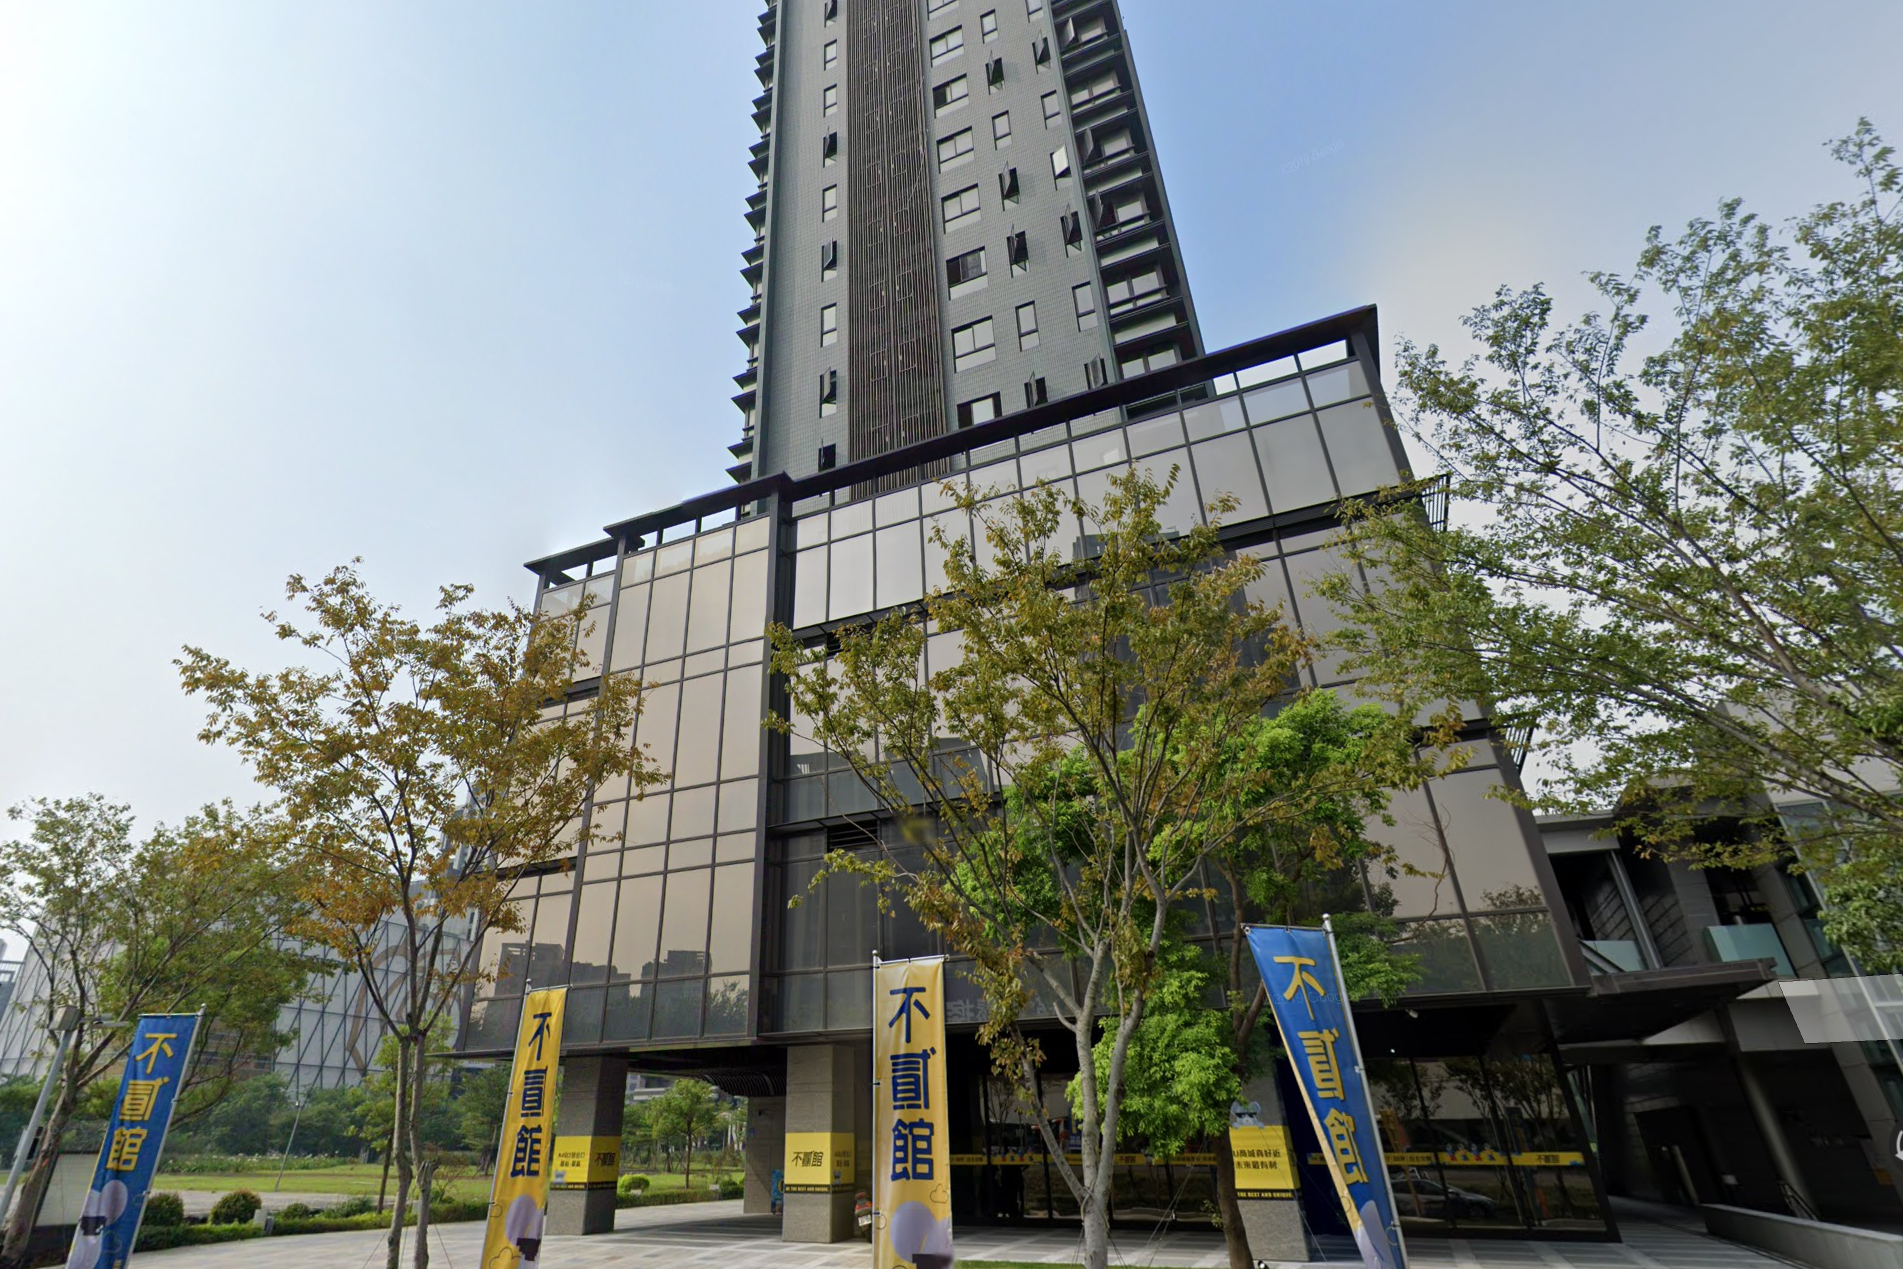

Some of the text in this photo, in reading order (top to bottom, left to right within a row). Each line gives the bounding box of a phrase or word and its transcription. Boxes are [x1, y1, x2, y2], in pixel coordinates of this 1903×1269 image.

[106, 1033, 178, 1171] 不貳館
[510, 1012, 552, 1178] 不貳館
[791, 1150, 824, 1167] 不貳館
[888, 986, 937, 1181] 不貳館
